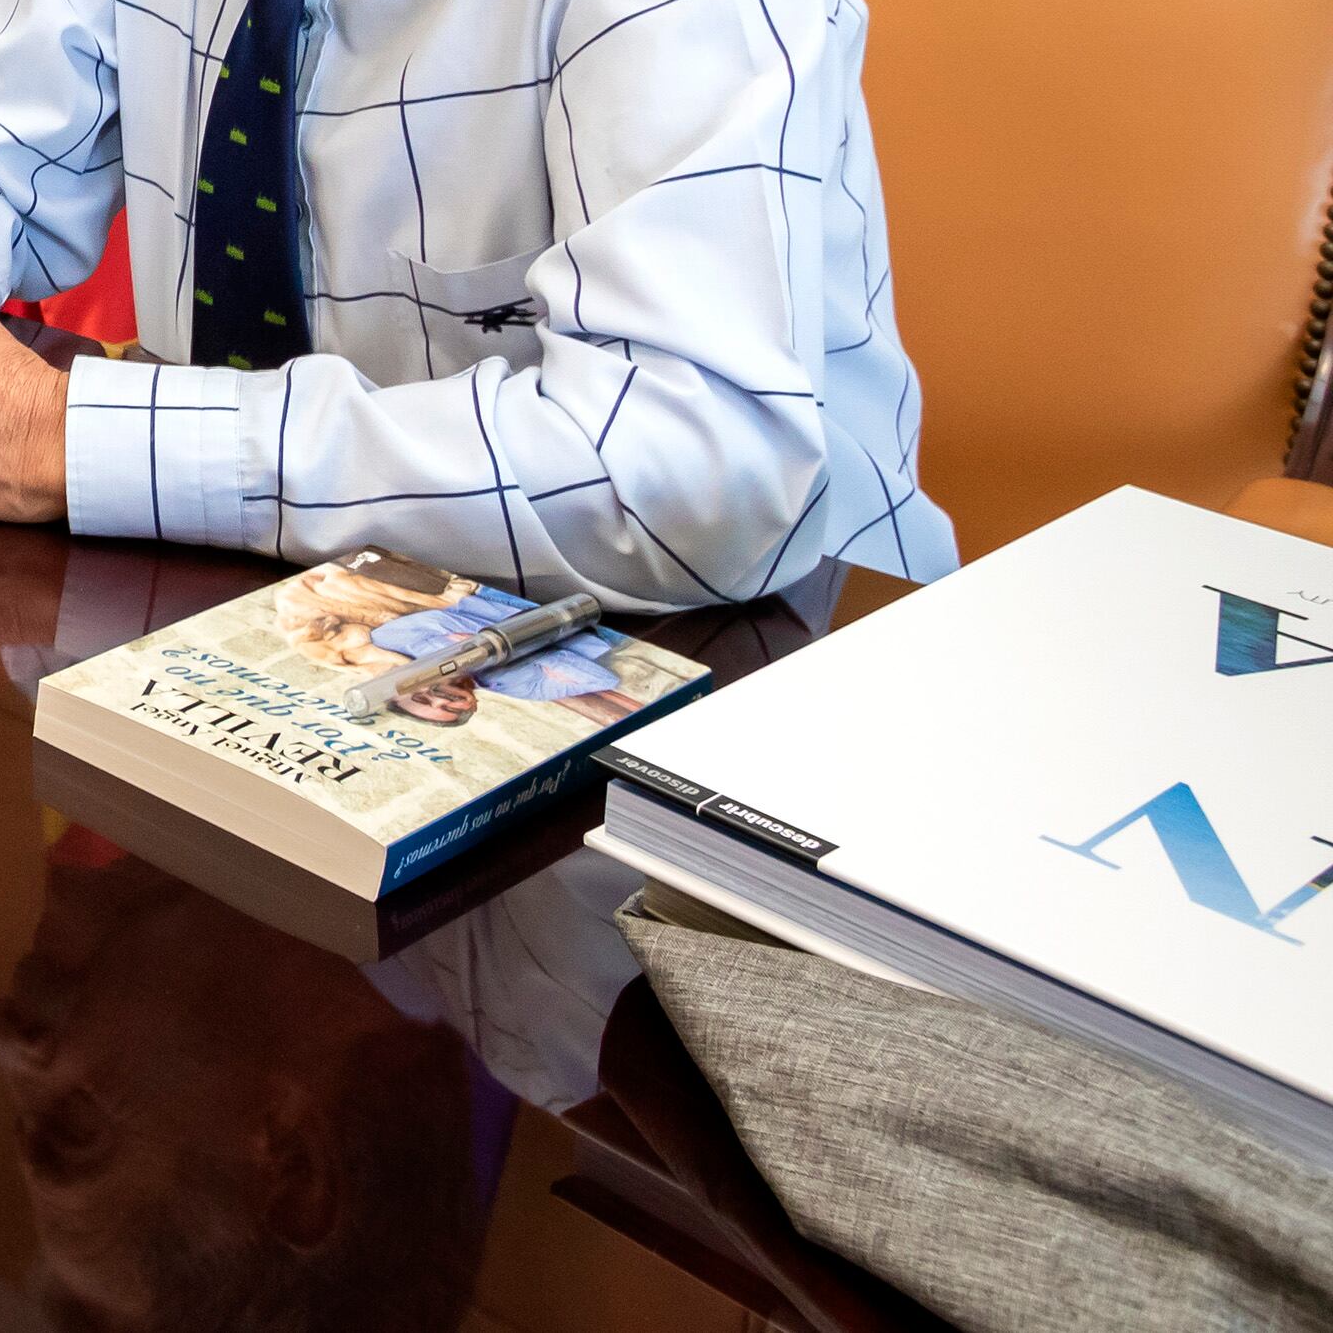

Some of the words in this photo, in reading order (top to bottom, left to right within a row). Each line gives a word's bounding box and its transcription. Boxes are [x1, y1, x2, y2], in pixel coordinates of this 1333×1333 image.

[160, 647, 379, 727] queremos?
[165, 666, 209, 687] no
[215, 679, 294, 717] qué
[129, 702, 210, 740] Ángel
[141, 679, 363, 785] REVILLA
[212, 737, 310, 784] Miguel
[377, 729, 453, 764] nos
[513, 776, 537, 810] qué
[616, 756, 700, 797] discover
[471, 811, 493, 832] nos
[495, 798, 513, 819] no
[719, 801, 822, 849] descubrir
[393, 814, 469, 880] queremos?
